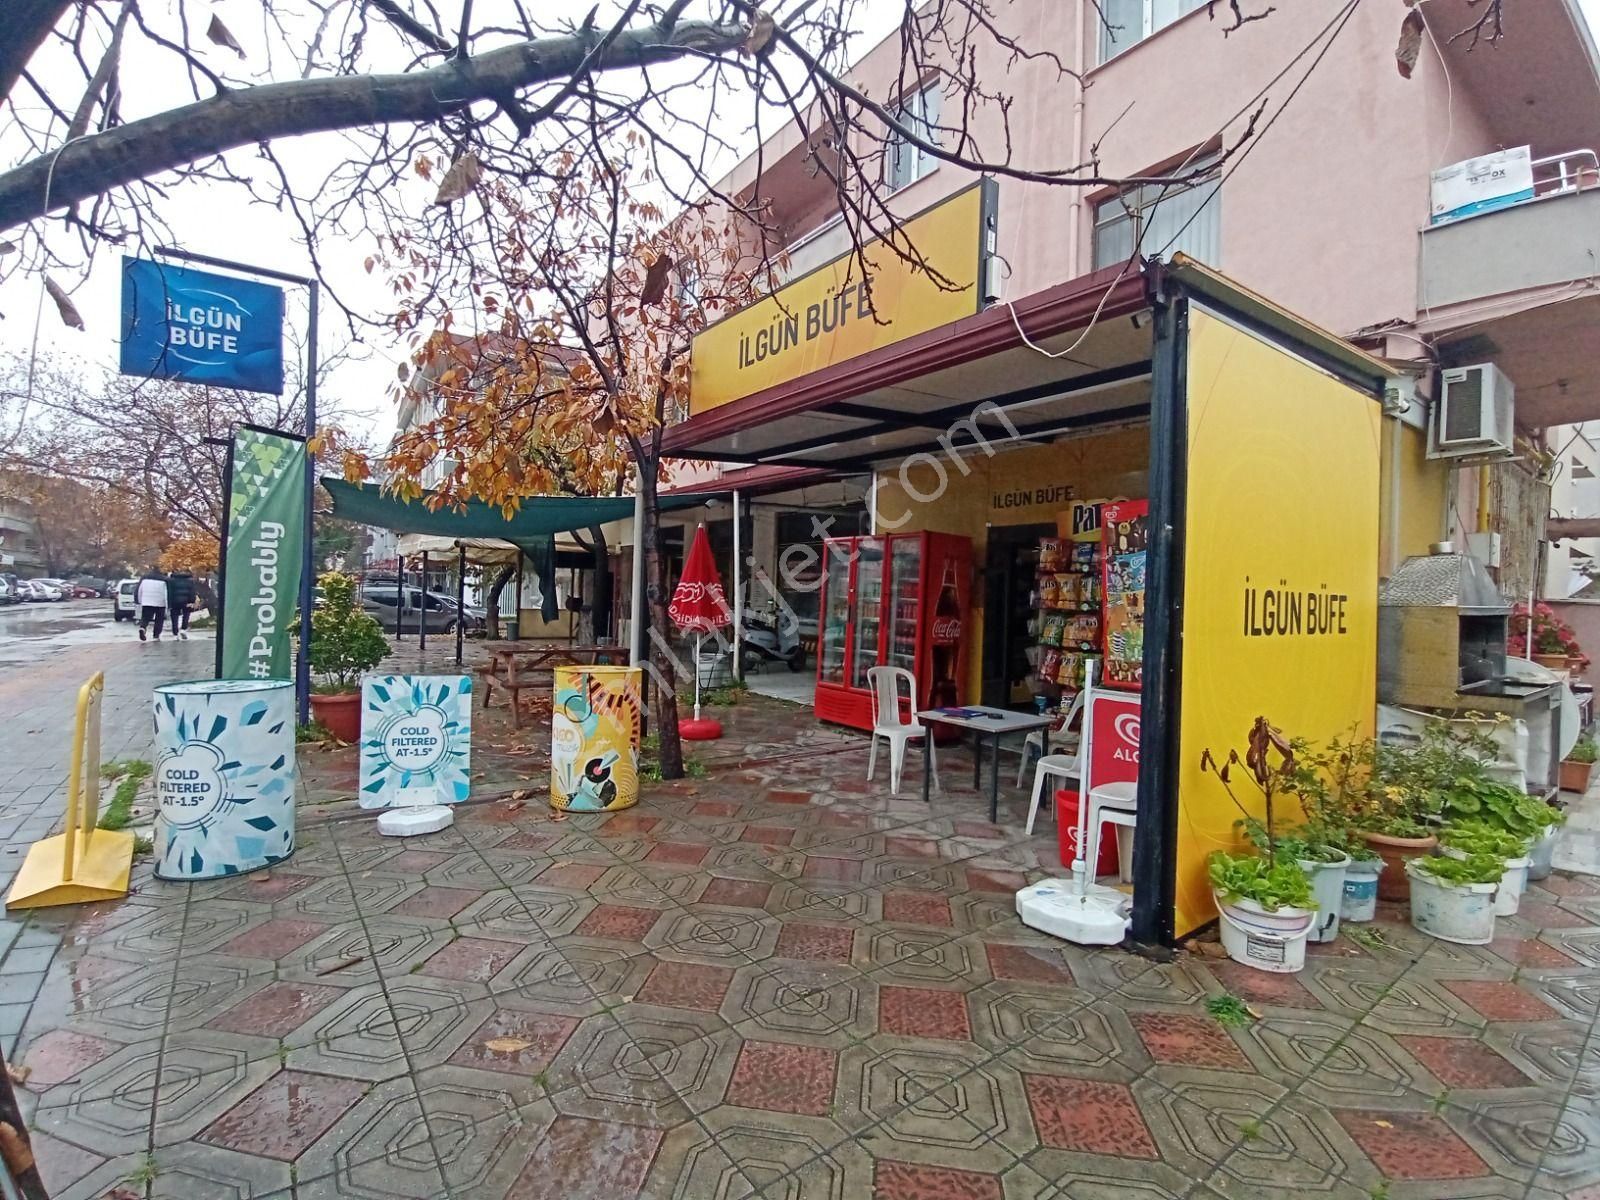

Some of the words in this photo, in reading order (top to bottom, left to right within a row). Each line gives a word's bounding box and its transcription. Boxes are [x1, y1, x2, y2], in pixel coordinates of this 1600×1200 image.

[167, 297, 241, 332] İLGÜN
[739, 313, 799, 370] İLGÜN
[806, 277, 874, 341] BÜFE
[170, 326, 238, 354] BÜFE
[993, 488, 1032, 509] İLGÜN
[1036, 484, 1074, 504] BÜFE
[248, 521, 285, 679] #Probably
[1244, 575, 1302, 636] İLGÜN
[1307, 583, 1347, 635] BÜFE
[391, 737, 437, 746] FILTERED
[400, 727, 429, 736] COLD
[159, 781, 211, 793] FILTERED
[166, 769, 200, 780] COLD
